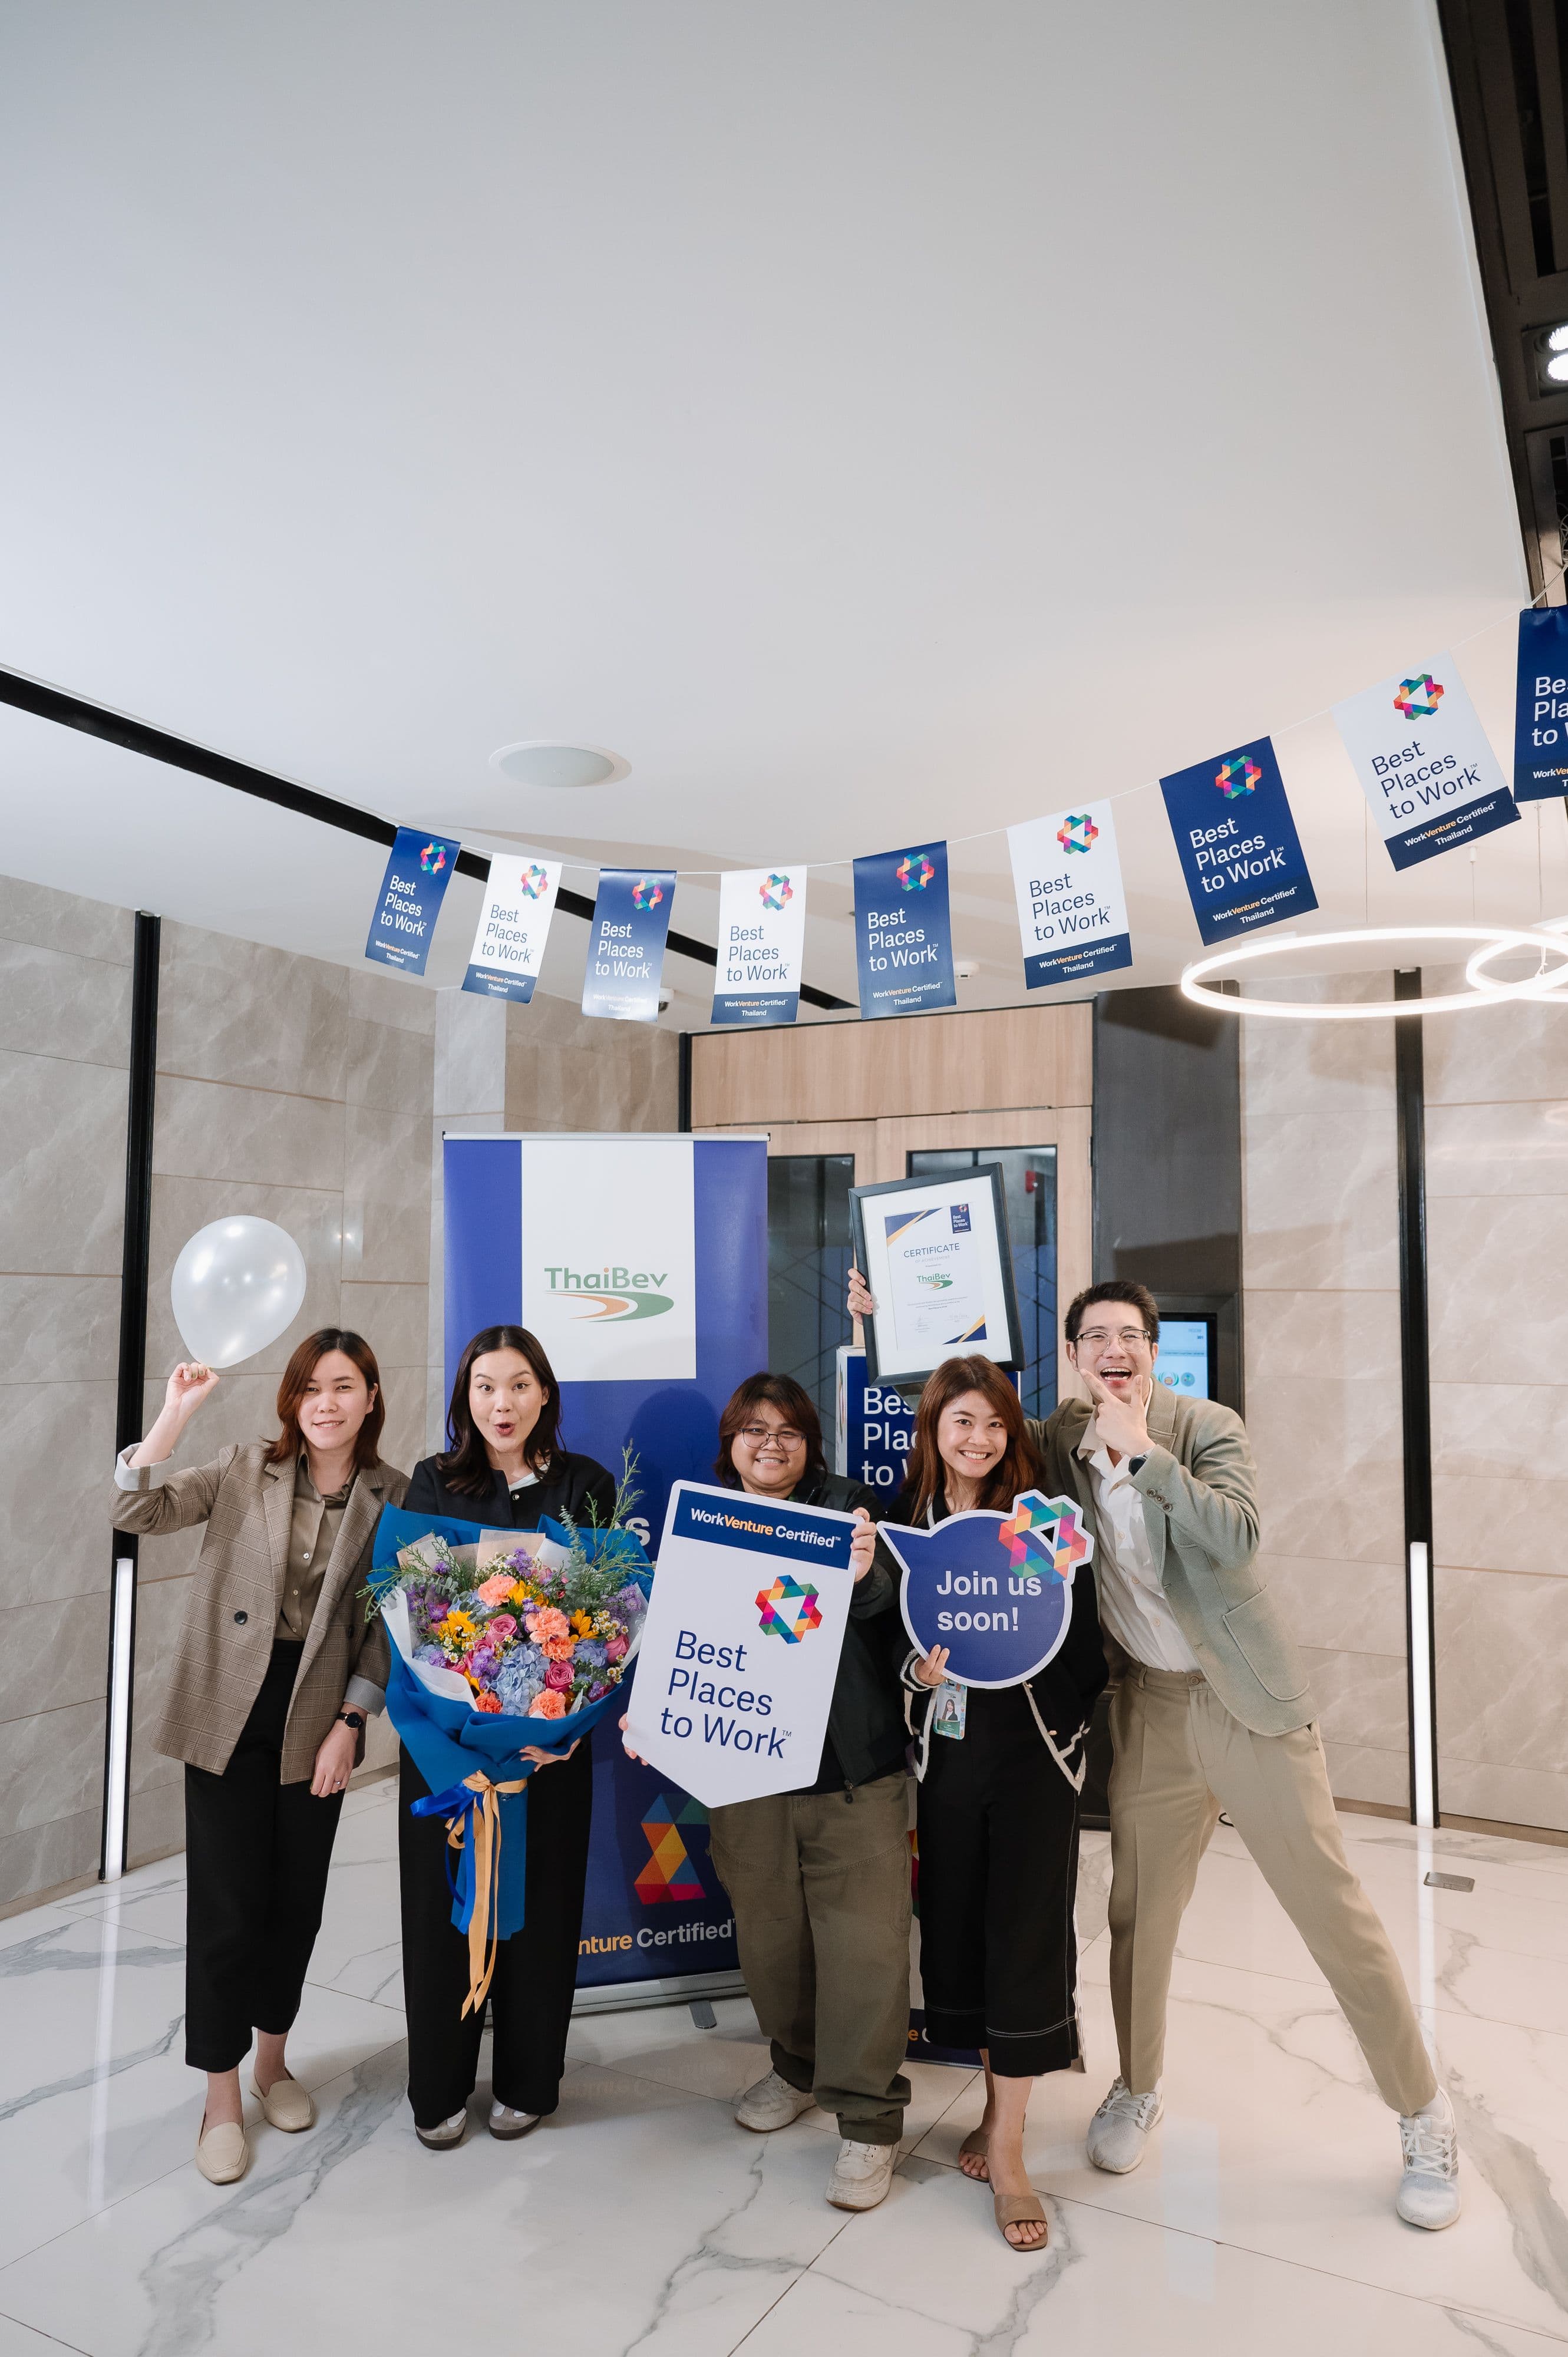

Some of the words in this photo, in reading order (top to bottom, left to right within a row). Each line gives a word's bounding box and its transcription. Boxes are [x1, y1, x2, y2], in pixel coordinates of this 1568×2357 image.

[1535, 675, 1568, 697] Be
[1534, 698, 1568, 722] Pla
[1532, 726, 1558, 747] to
[1371, 741, 1425, 776] Best
[1380, 754, 1457, 798] Places
[1389, 794, 1415, 820] to
[1190, 818, 1239, 849] Best
[1404, 820, 1457, 847] WorkVenture
[1435, 825, 1473, 846] Thailand
[1195, 834, 1266, 871] Places
[389, 875, 416, 896] Best
[1029, 873, 1073, 898] Best
[1201, 869, 1224, 894] to
[384, 893, 422, 916] Places
[490, 904, 519, 923] Best
[1032, 892, 1095, 920] Places
[1212, 900, 1260, 922] WorkVenture
[381, 910, 393, 927] to
[867, 907, 906, 930] Best
[1240, 907, 1275, 925] Thailand
[486, 923, 527, 943] Places
[600, 921, 632, 938] Best
[730, 925, 764, 941] Best
[869, 928, 925, 950] Places
[1034, 920, 1054, 941] to
[375, 940, 400, 954] WorkVenture
[481, 942, 496, 956] to
[598, 940, 644, 958] Places
[729, 946, 779, 962] Places
[386, 953, 404, 964] Thailand
[595, 960, 610, 976] to
[869, 953, 887, 972] to
[1039, 953, 1082, 968] WorkVenture
[1062, 961, 1094, 973] Thailand
[476, 972, 503, 983] WorkVenture
[727, 966, 742, 982] to
[487, 983, 508, 993] Thailand
[873, 986, 912, 998] WorkVenture
[893, 996, 922, 1006] Thailand
[903, 1243, 960, 1257] CERTIFICATE
[544, 1267, 668, 1289] ThaiBev
[916, 1273, 950, 1283] ThaiBev
[861, 1460, 893, 1486] to
[691, 1508, 773, 1536] WorkVenture
[936, 1571, 998, 1596] Join
[1008, 1577, 1042, 1596] us
[937, 1607, 1019, 1632] soon!
[675, 1630, 747, 1672] Best
[668, 1668, 773, 1716] Places
[661, 1707, 692, 1738] to
